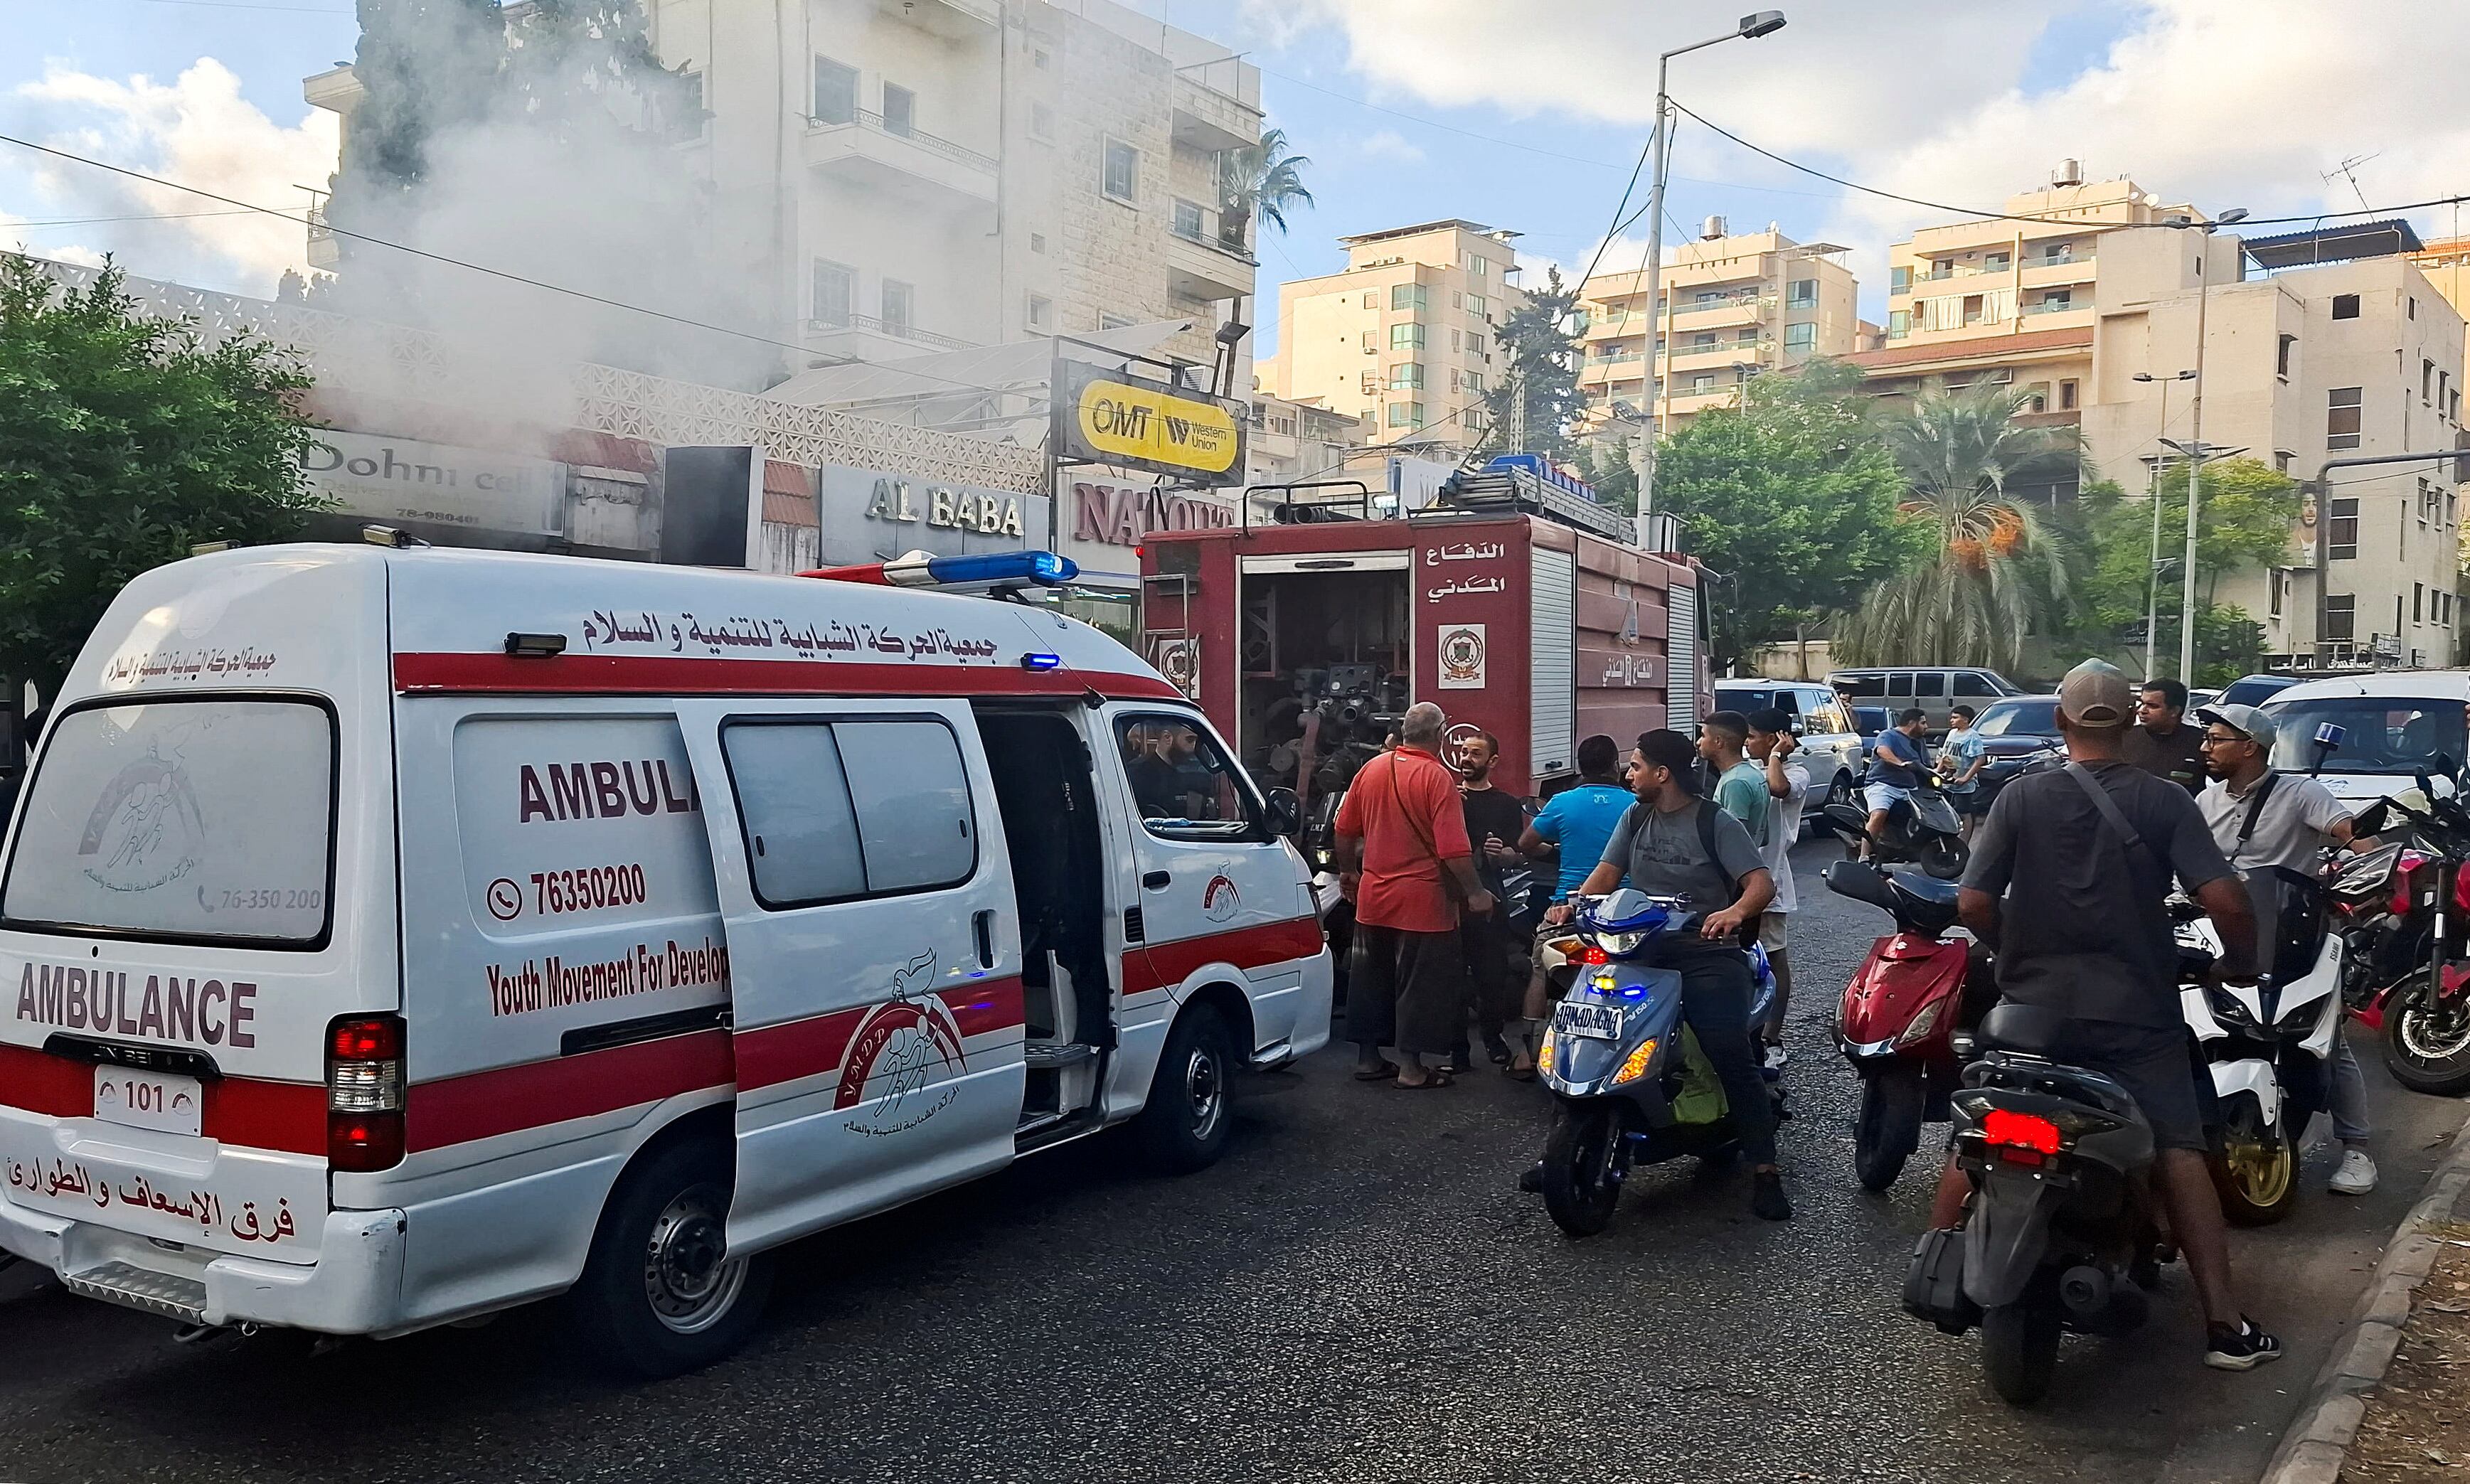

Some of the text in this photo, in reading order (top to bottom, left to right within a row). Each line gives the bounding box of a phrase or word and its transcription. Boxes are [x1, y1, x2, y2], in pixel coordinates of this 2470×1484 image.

[1092, 397, 1153, 440] OMT
[1191, 421, 1228, 441] Western
[1191, 436, 1218, 452] Union
[865, 478, 1025, 537] AL BABA
[582, 609, 663, 653] السلام
[683, 612, 772, 656] للتنمية
[772, 618, 863, 660] الشبابية
[867, 623, 944, 661] الحركة
[943, 635, 998, 665] جمعية
[221, 890, 321, 909] 76-350 200
[530, 863, 646, 915] 76350200
[486, 959, 543, 1018] Youth
[545, 946, 636, 1008] Movement
[637, 944, 666, 993] For
[16, 962, 257, 1049] AMBULANCE
[124, 1080, 163, 1114] 101
[118, 1174, 223, 1238] الإسعاف
[230, 1196, 296, 1244] فرق
